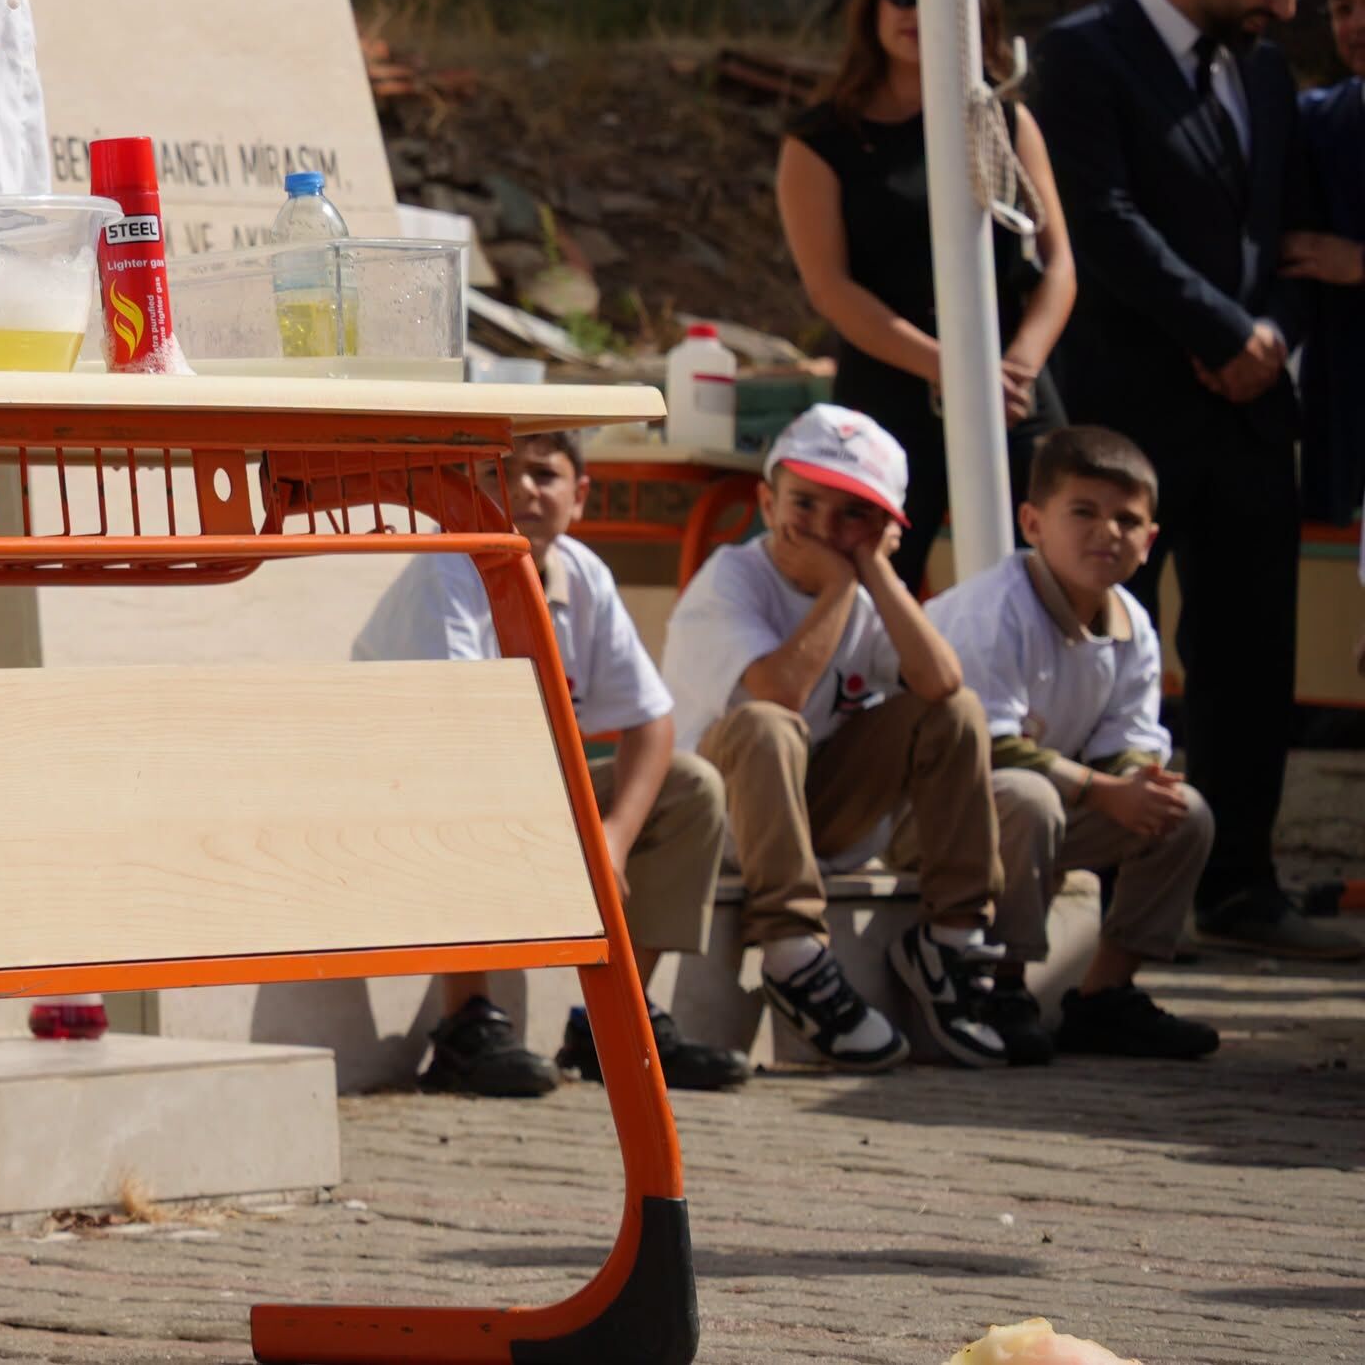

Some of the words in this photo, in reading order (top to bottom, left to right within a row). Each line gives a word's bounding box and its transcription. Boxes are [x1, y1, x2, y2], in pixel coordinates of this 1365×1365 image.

[157, 134, 230, 187] ANEVİ
[108, 221, 157, 239] STEEL
[107, 258, 148, 272] Lighter
[150, 258, 165, 270] gas
